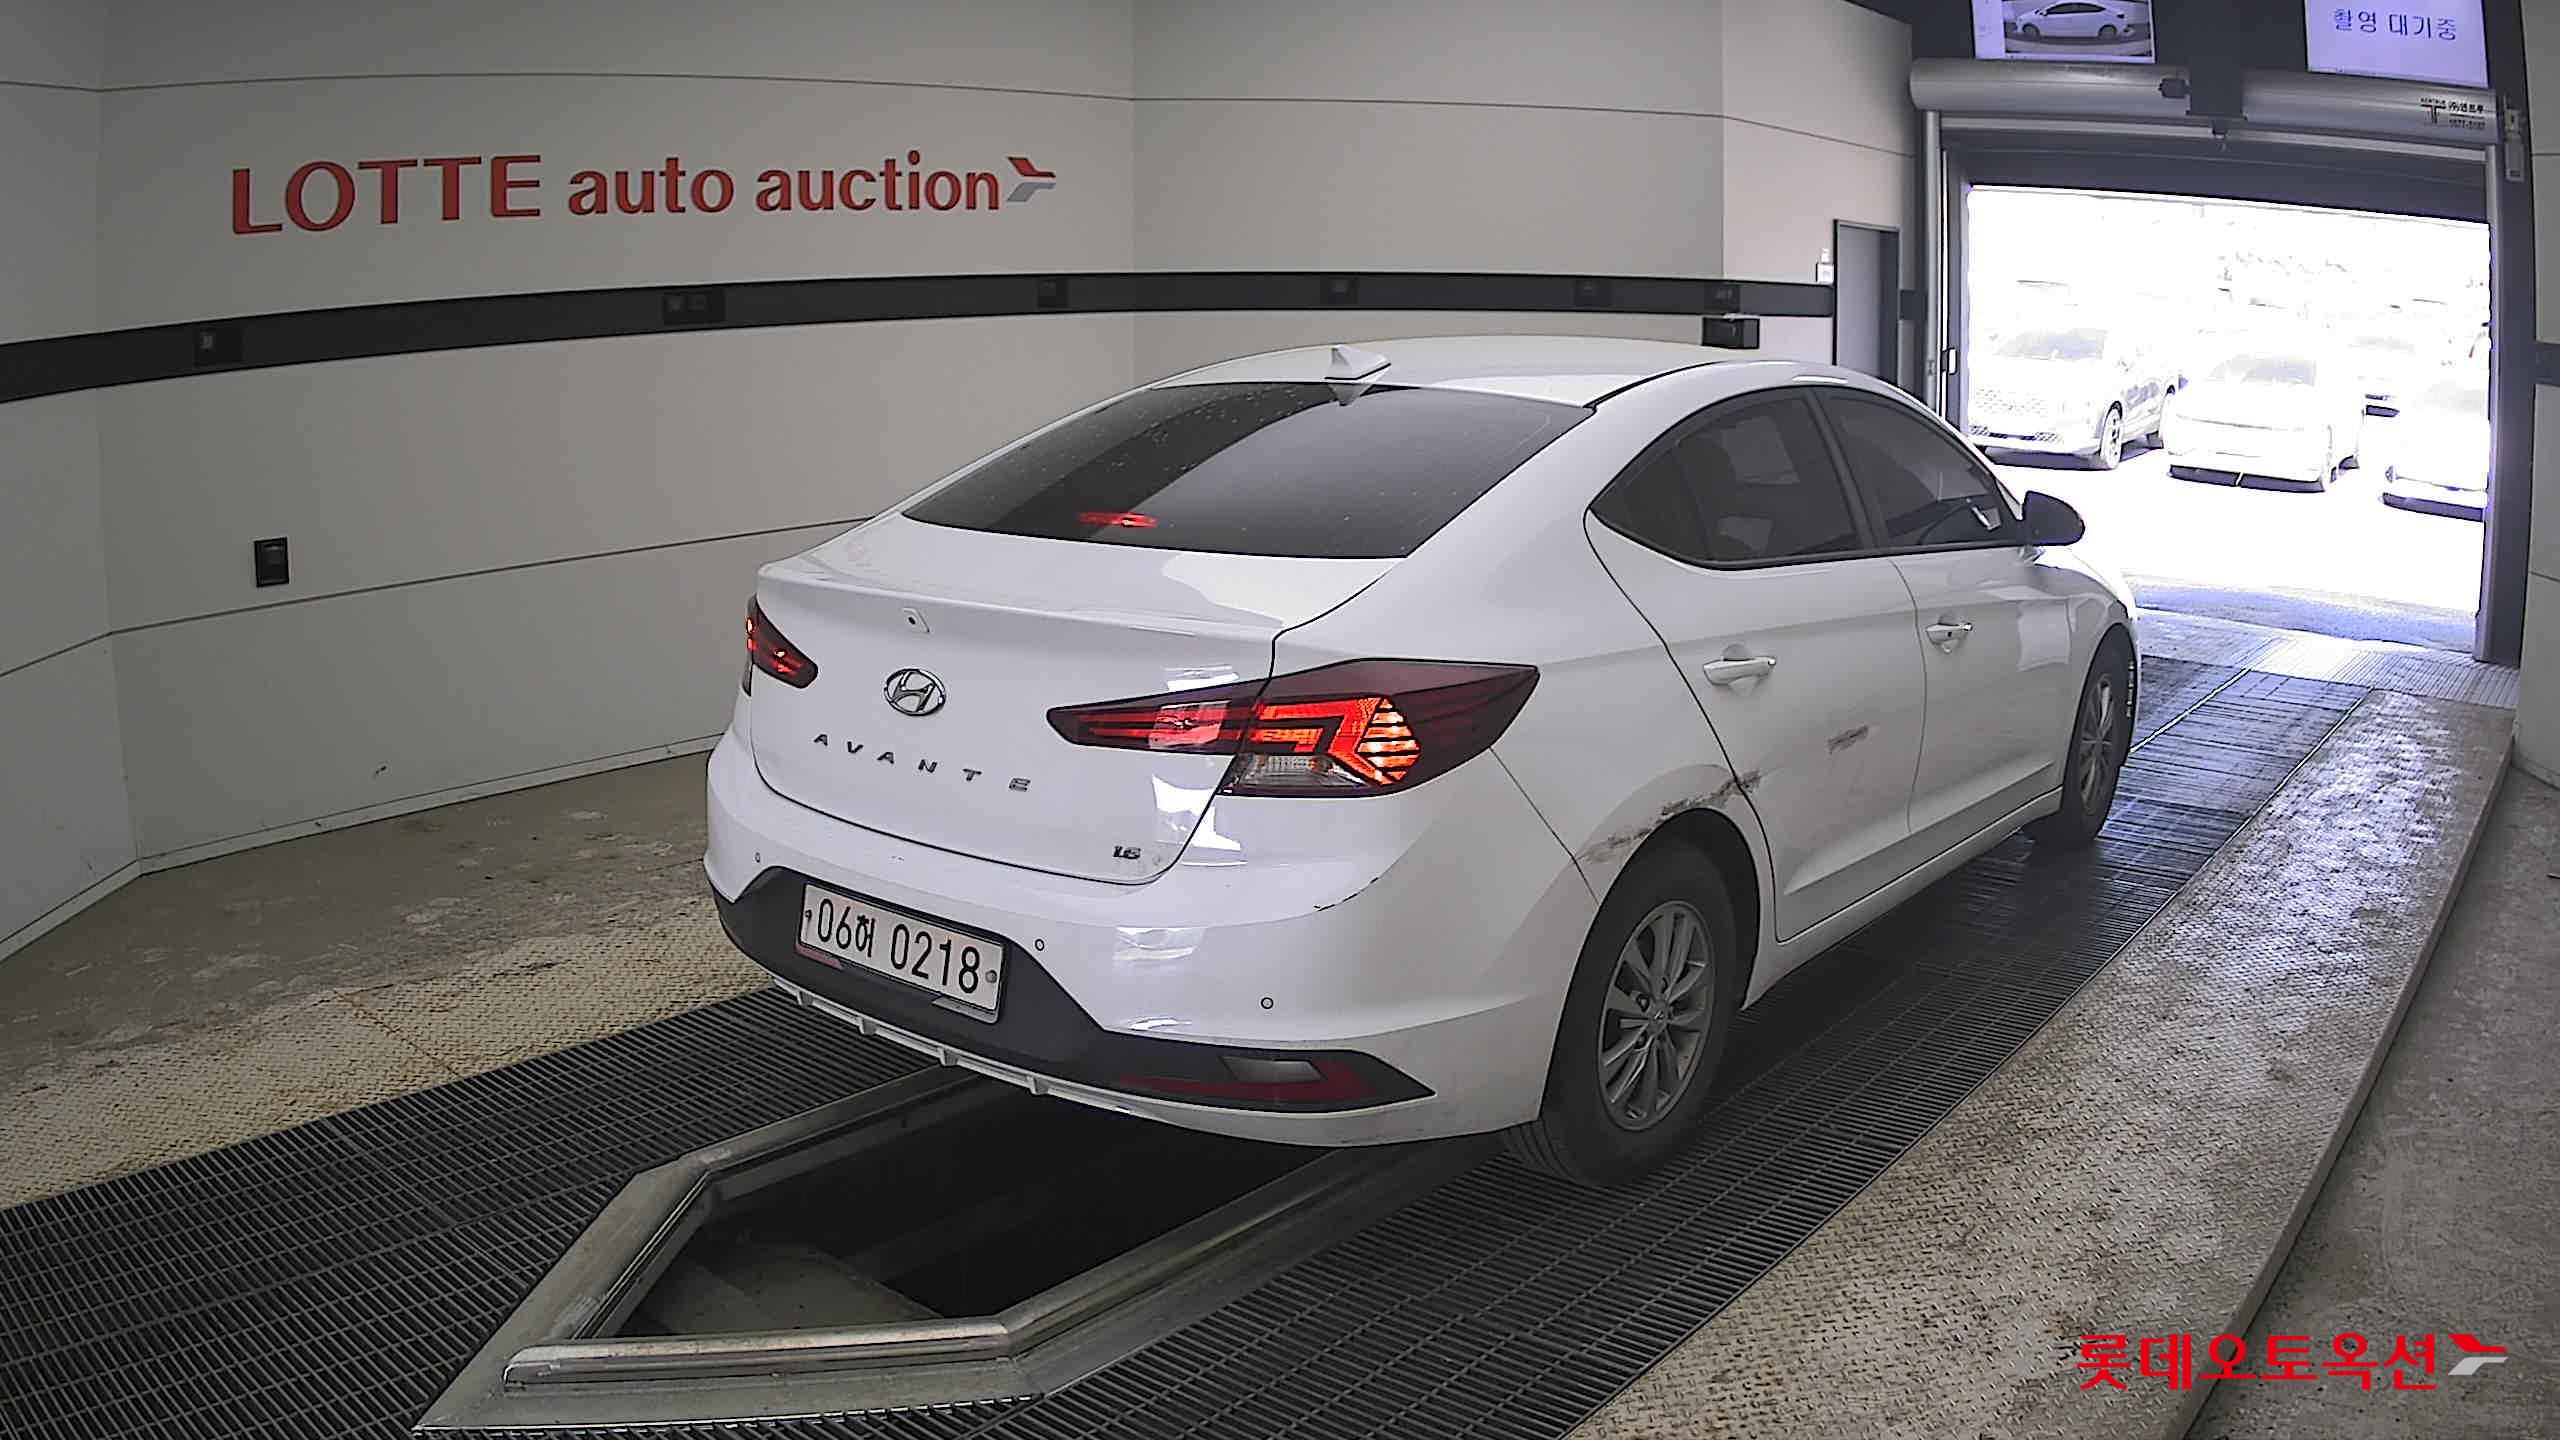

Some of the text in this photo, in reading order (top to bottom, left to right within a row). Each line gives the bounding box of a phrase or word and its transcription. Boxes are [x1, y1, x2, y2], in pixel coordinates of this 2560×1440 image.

[2334, 8, 2457, 41] 촬영 대기중
[232, 150, 1001, 236] LOTTE auto auction
[812, 733, 1031, 792] AVANTE
[817, 898, 981, 994] 06허 0218
